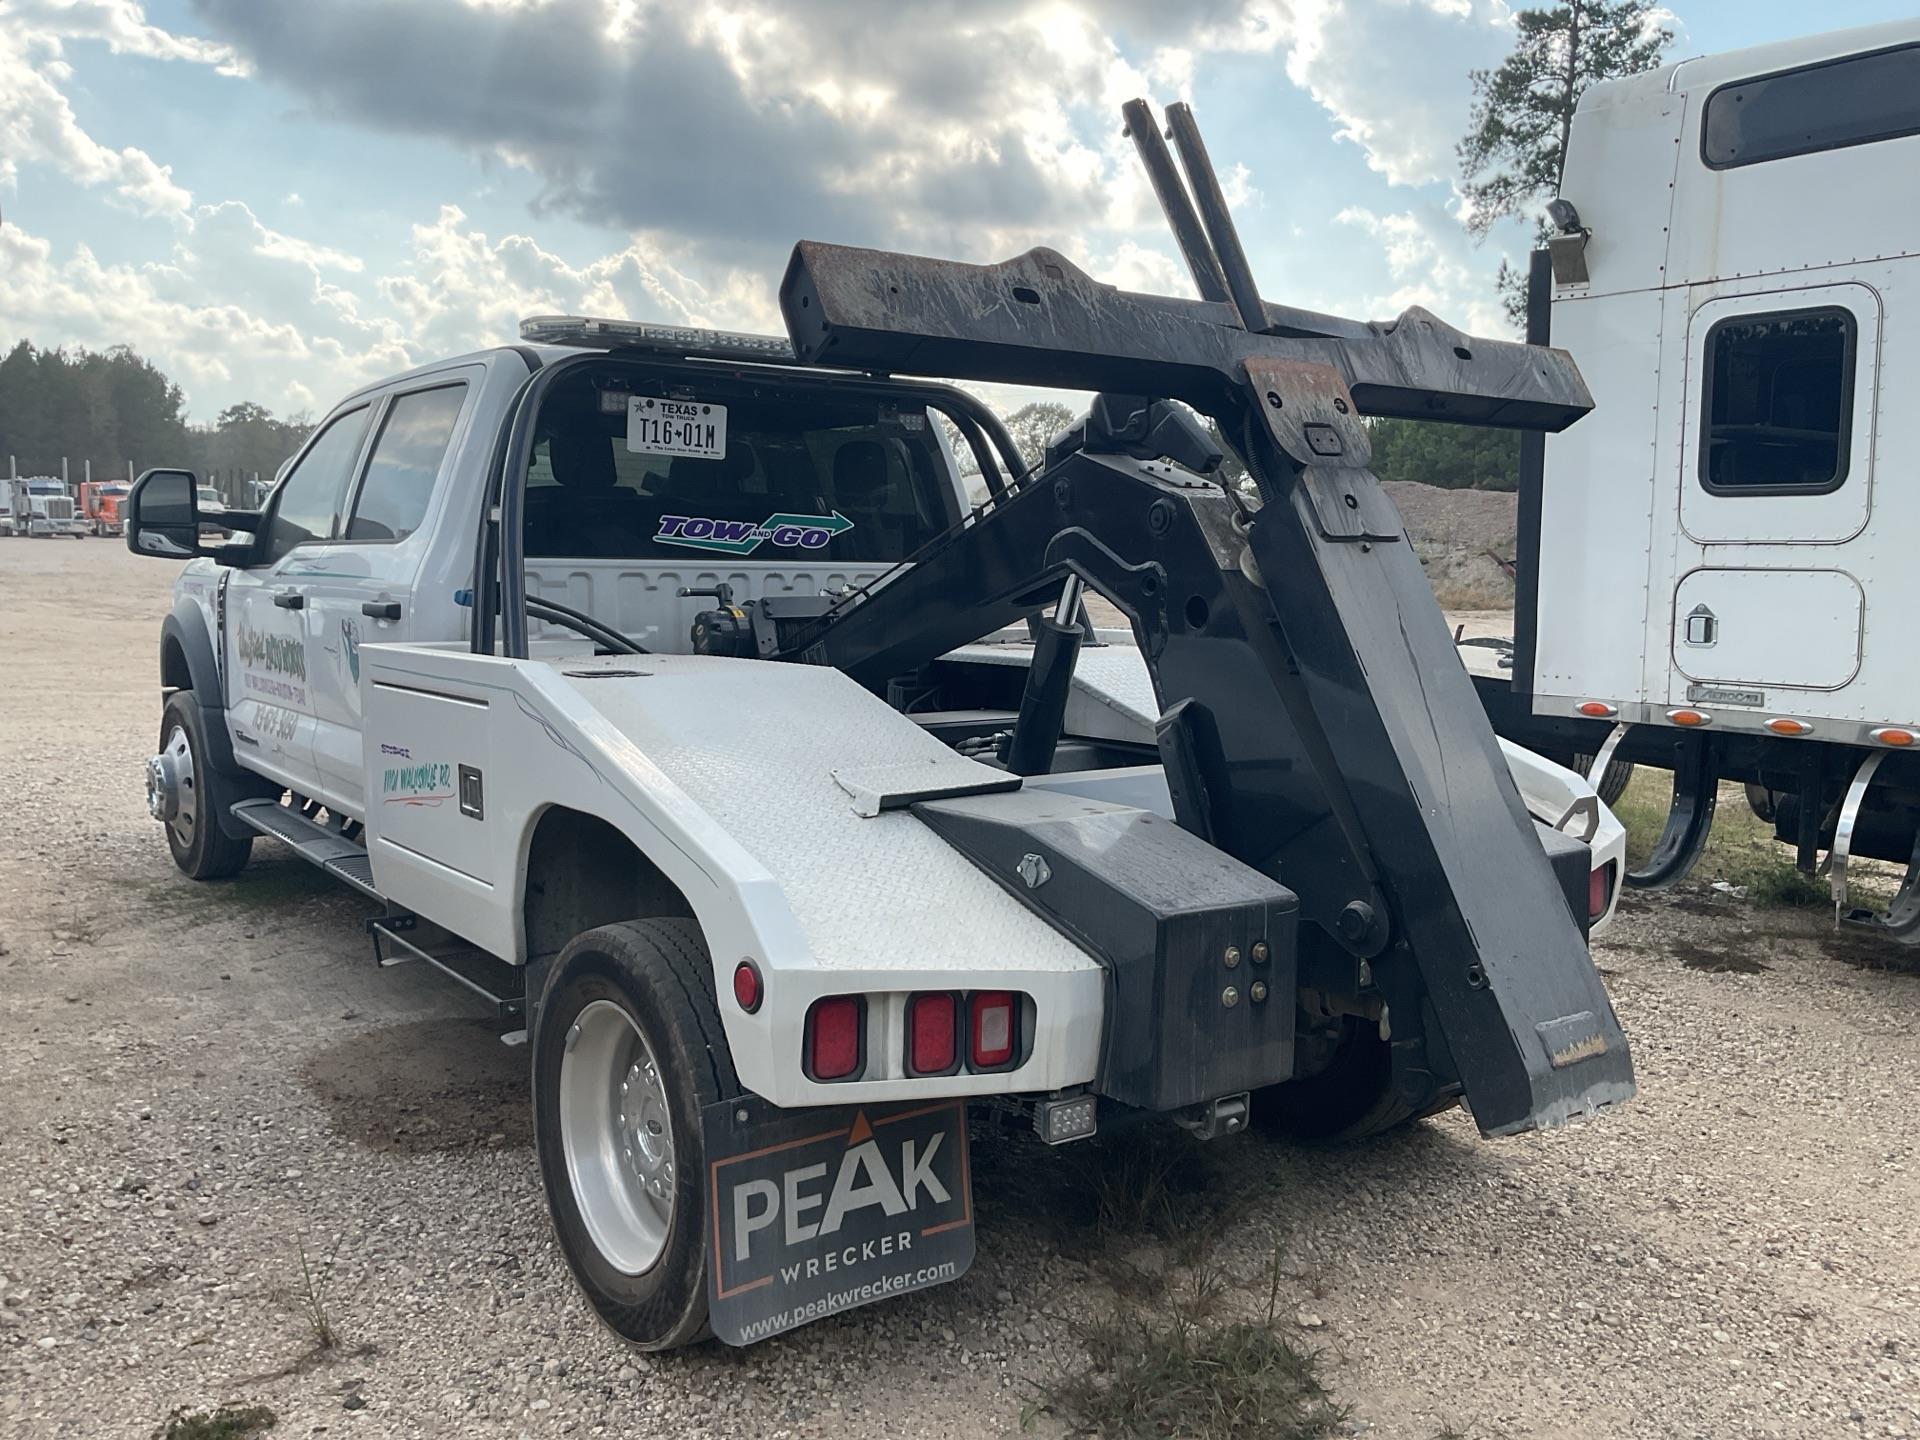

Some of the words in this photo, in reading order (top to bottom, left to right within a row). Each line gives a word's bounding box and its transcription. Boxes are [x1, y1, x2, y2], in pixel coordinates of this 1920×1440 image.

[640, 418, 672, 445] T16
[660, 403, 698, 416] TEXAS
[658, 515, 757, 541] TOW
[751, 530, 771, 539] AND
[772, 527, 830, 549] GO
[733, 1131, 952, 1262] PEAK
[780, 1231, 912, 1285] WRECKER
[739, 1260, 956, 1342] www.peakwrecker.com
